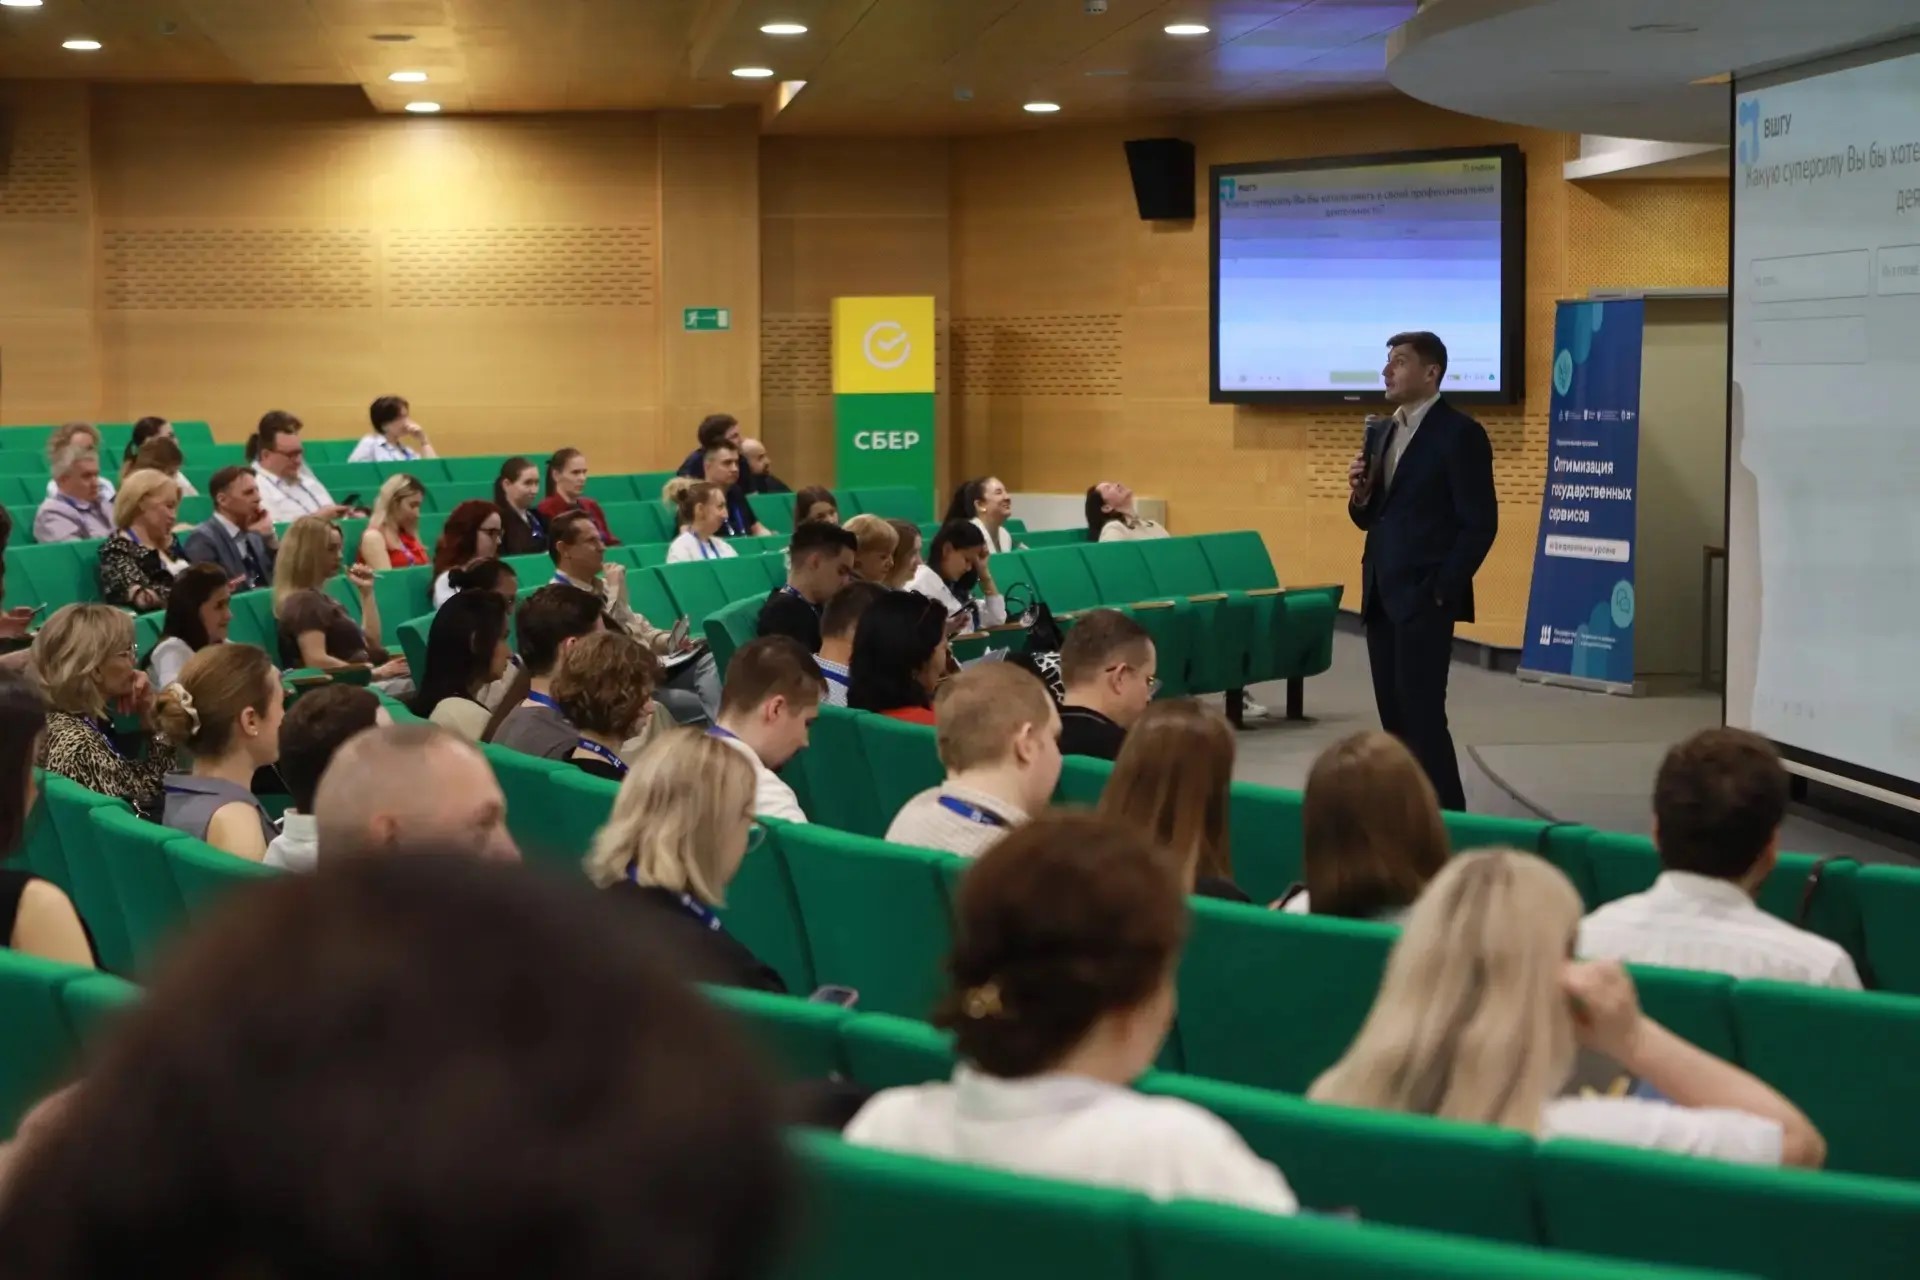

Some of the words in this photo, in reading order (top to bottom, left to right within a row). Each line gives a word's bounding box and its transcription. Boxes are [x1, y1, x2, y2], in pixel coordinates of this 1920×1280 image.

[1764, 113, 1792, 139] ВШГУ
[1783, 154, 1844, 185] суперсилу
[1847, 144, 1866, 173] Вы
[1869, 140, 1886, 169] бы
[854, 430, 920, 450] СБЕР
[1553, 456, 1614, 476] Оптимизация
[1551, 484, 1632, 502] государственных
[1548, 507, 1590, 524] сервисов
